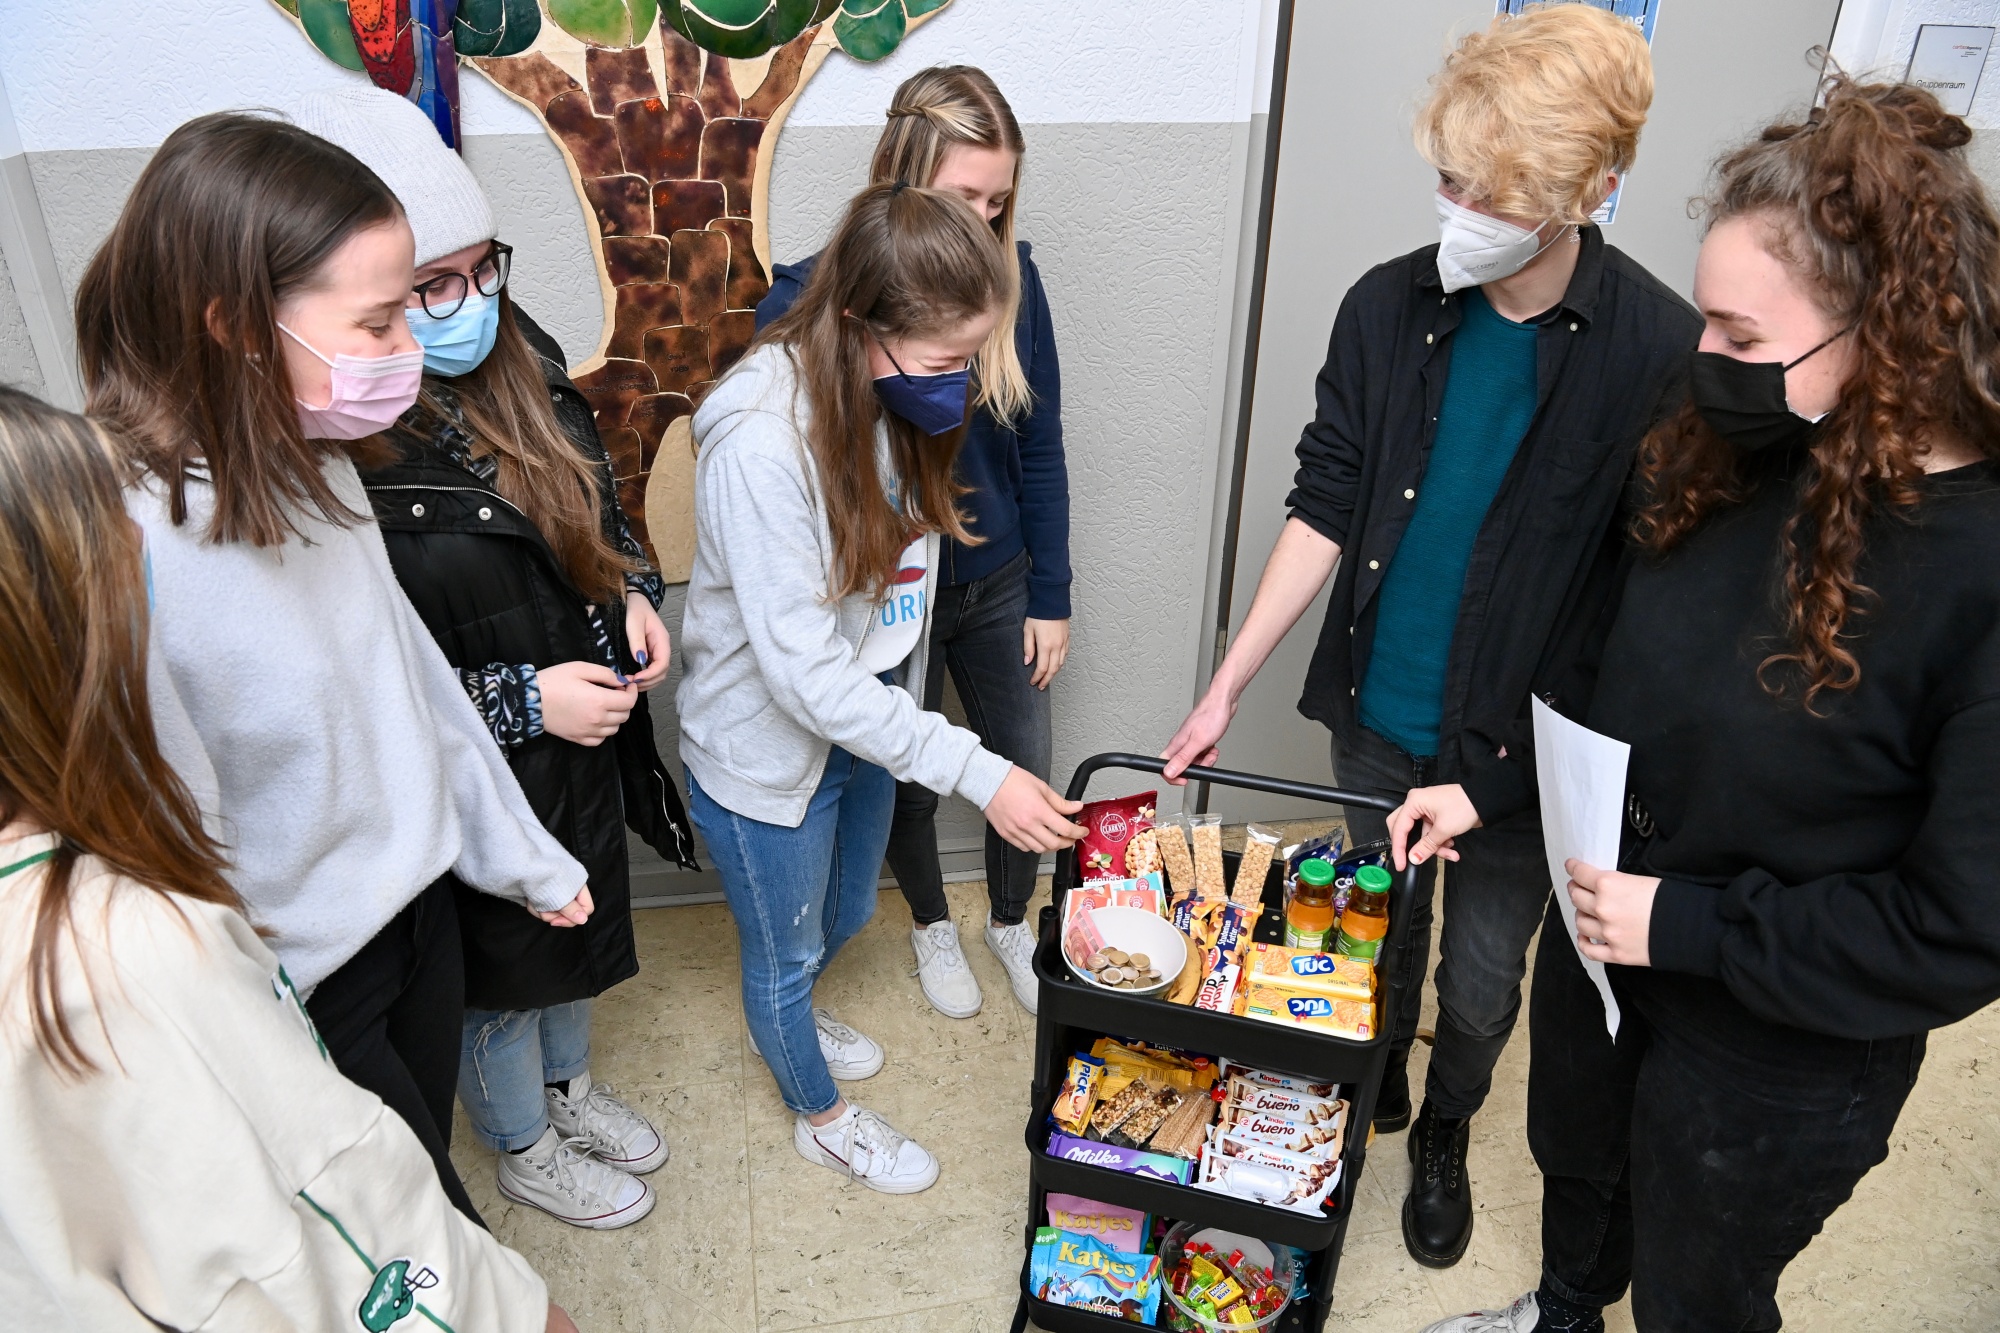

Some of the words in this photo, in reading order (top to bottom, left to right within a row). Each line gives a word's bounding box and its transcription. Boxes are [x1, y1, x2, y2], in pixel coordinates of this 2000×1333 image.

[1916, 79, 1966, 90] Gruppenraum
[1217, 920, 1232, 946] Studenten
[1228, 927, 1239, 945] Futter
[1294, 957, 1331, 973] TUC
[1327, 978, 1350, 987] ORIGINAL
[1290, 999, 1330, 1016] TUC
[1256, 1096, 1300, 1112] bueno
[1251, 1118, 1295, 1135] bueno
[1063, 1146, 1123, 1165] Milka
[1055, 1210, 1134, 1235] Katjes
[1058, 1241, 1137, 1279] Katjes
[1209, 1281, 1228, 1298] MAOAM
